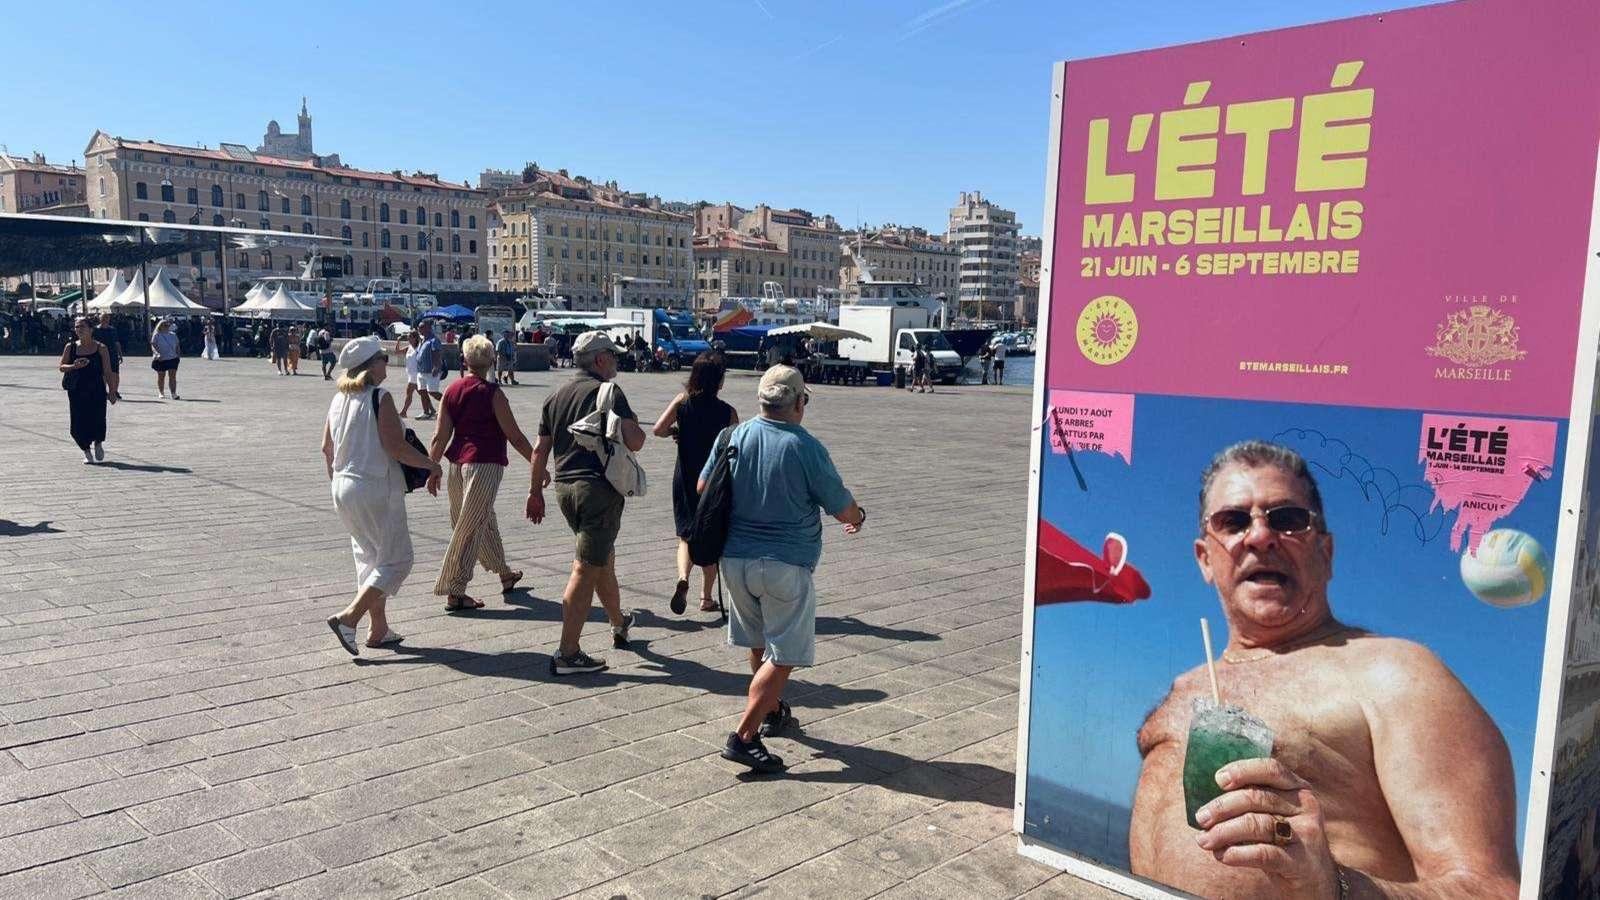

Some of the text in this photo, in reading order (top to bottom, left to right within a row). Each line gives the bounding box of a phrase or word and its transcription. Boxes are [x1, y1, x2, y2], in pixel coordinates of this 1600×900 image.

[1085, 61, 1374, 205] L'ÉTÉ
[1082, 200, 1364, 248] MARSEILLAIS
[1081, 256, 1101, 277] 21
[1105, 255, 1158, 276] JUIN
[1175, 254, 1191, 275] 6
[1196, 249, 1360, 276] SEPTEMBRE
[1445, 294, 1489, 304] VILLE
[1434, 367, 1513, 381] MARSEILLE
[1080, 408, 1089, 416] 17
[1064, 418, 1094, 428] ARBRES
[1089, 431, 1105, 441] PAR
[1427, 422, 1509, 455] L'ÉTÉ
[1426, 450, 1506, 467] MARSEILLAIS
[1461, 465, 1505, 475] SEPTEMBRE
